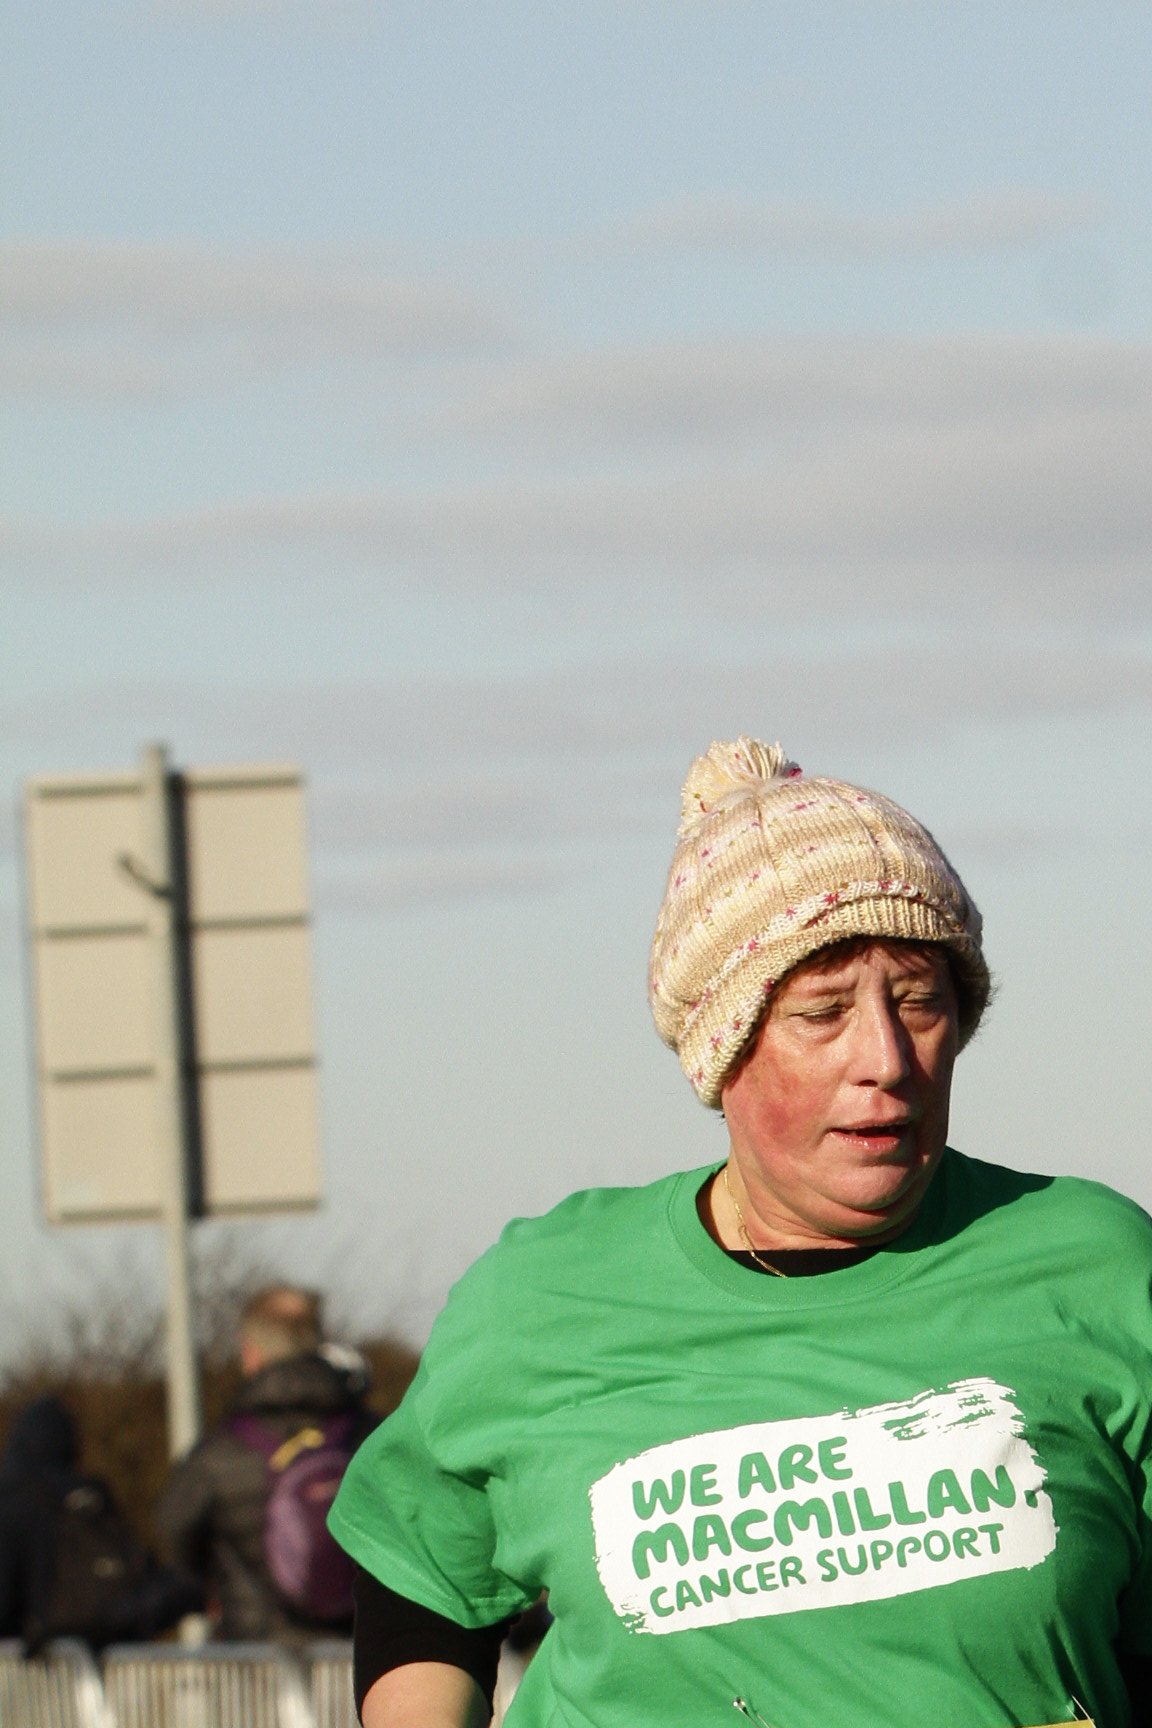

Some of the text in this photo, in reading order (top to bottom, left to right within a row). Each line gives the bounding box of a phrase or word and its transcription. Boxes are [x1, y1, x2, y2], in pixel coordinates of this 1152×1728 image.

[632, 1436, 853, 1520] WE ARE
[648, 1522, 1004, 1617] CANCER SUPPORT
